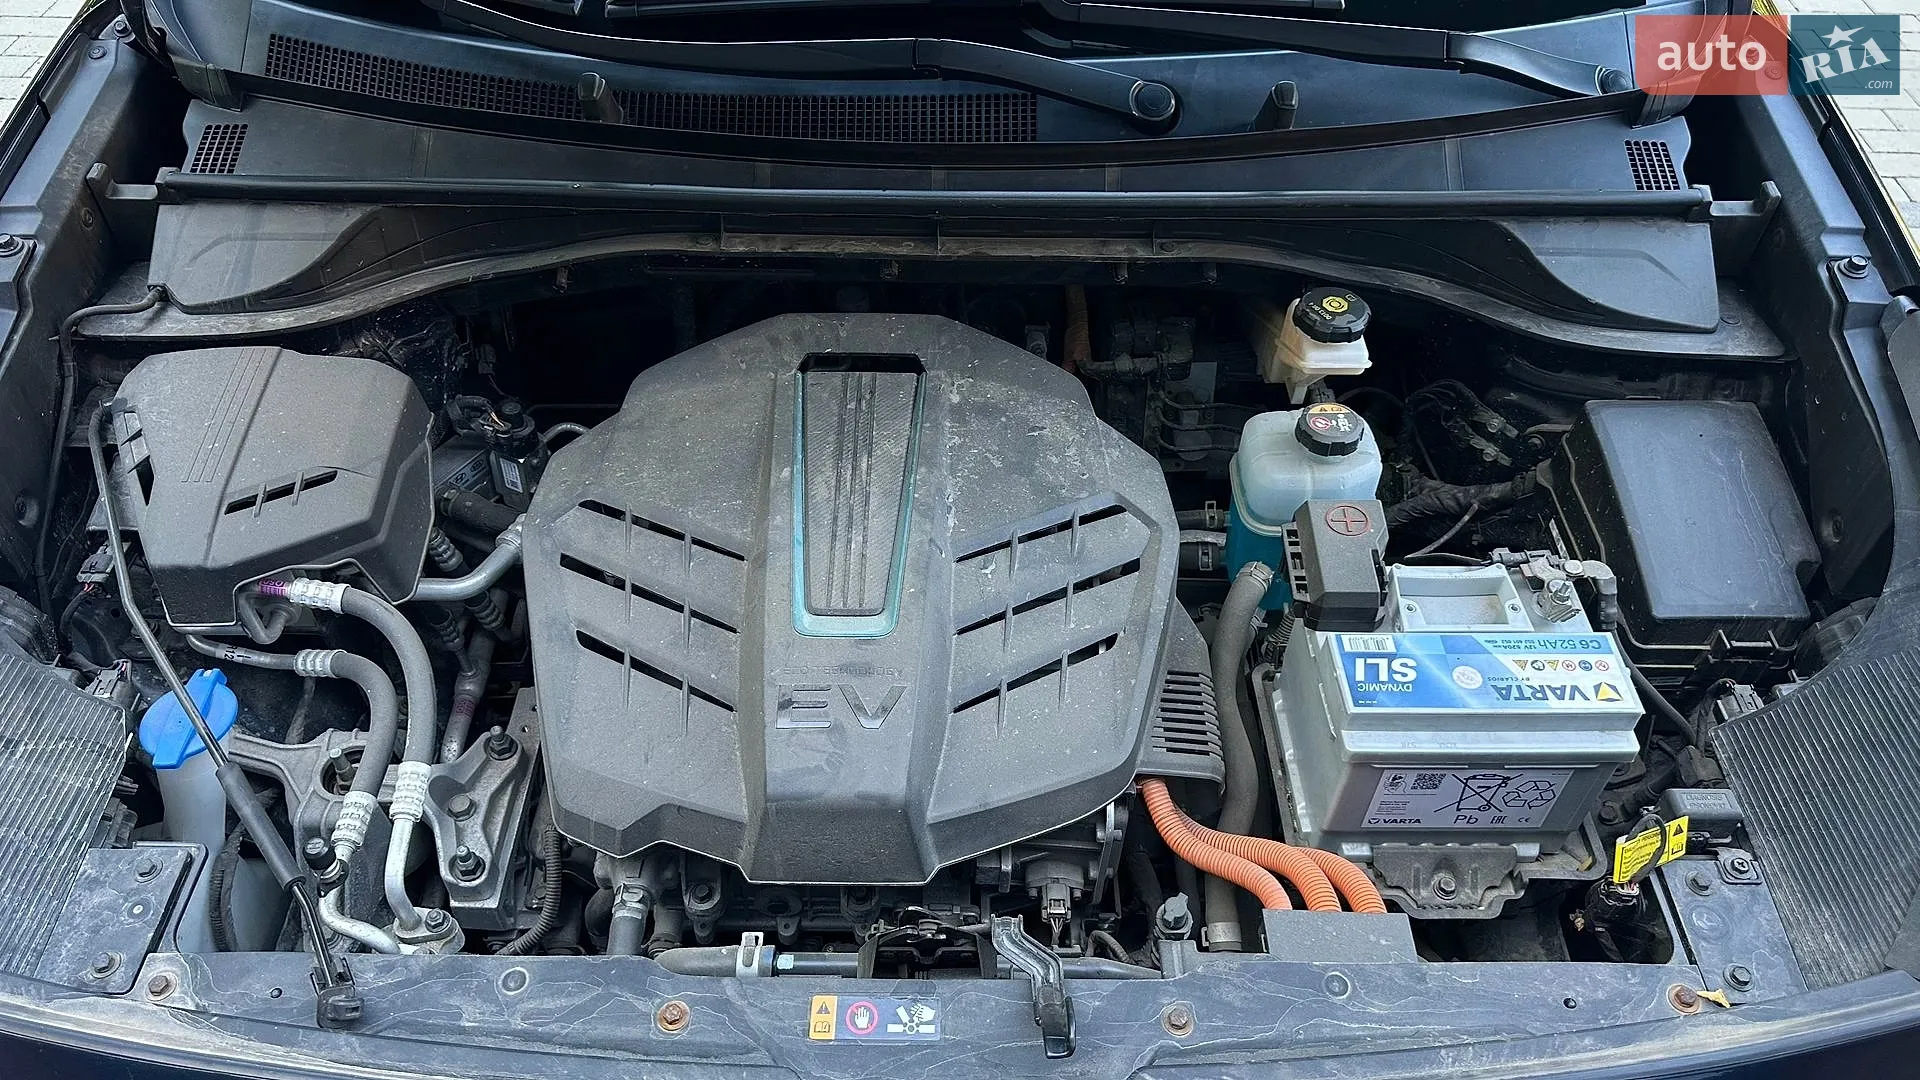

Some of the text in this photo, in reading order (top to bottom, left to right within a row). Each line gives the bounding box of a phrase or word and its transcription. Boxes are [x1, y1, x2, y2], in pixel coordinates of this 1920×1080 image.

[1537, 639, 1602, 650] C6 52Ah
[1355, 657, 1417, 682] SLI
[1357, 682, 1412, 692] DYNAMIC
[1491, 684, 1591, 701] VARTA
[775, 684, 907, 729] EV
[1383, 817, 1422, 825] VARTA
[1454, 814, 1479, 825] Pb
